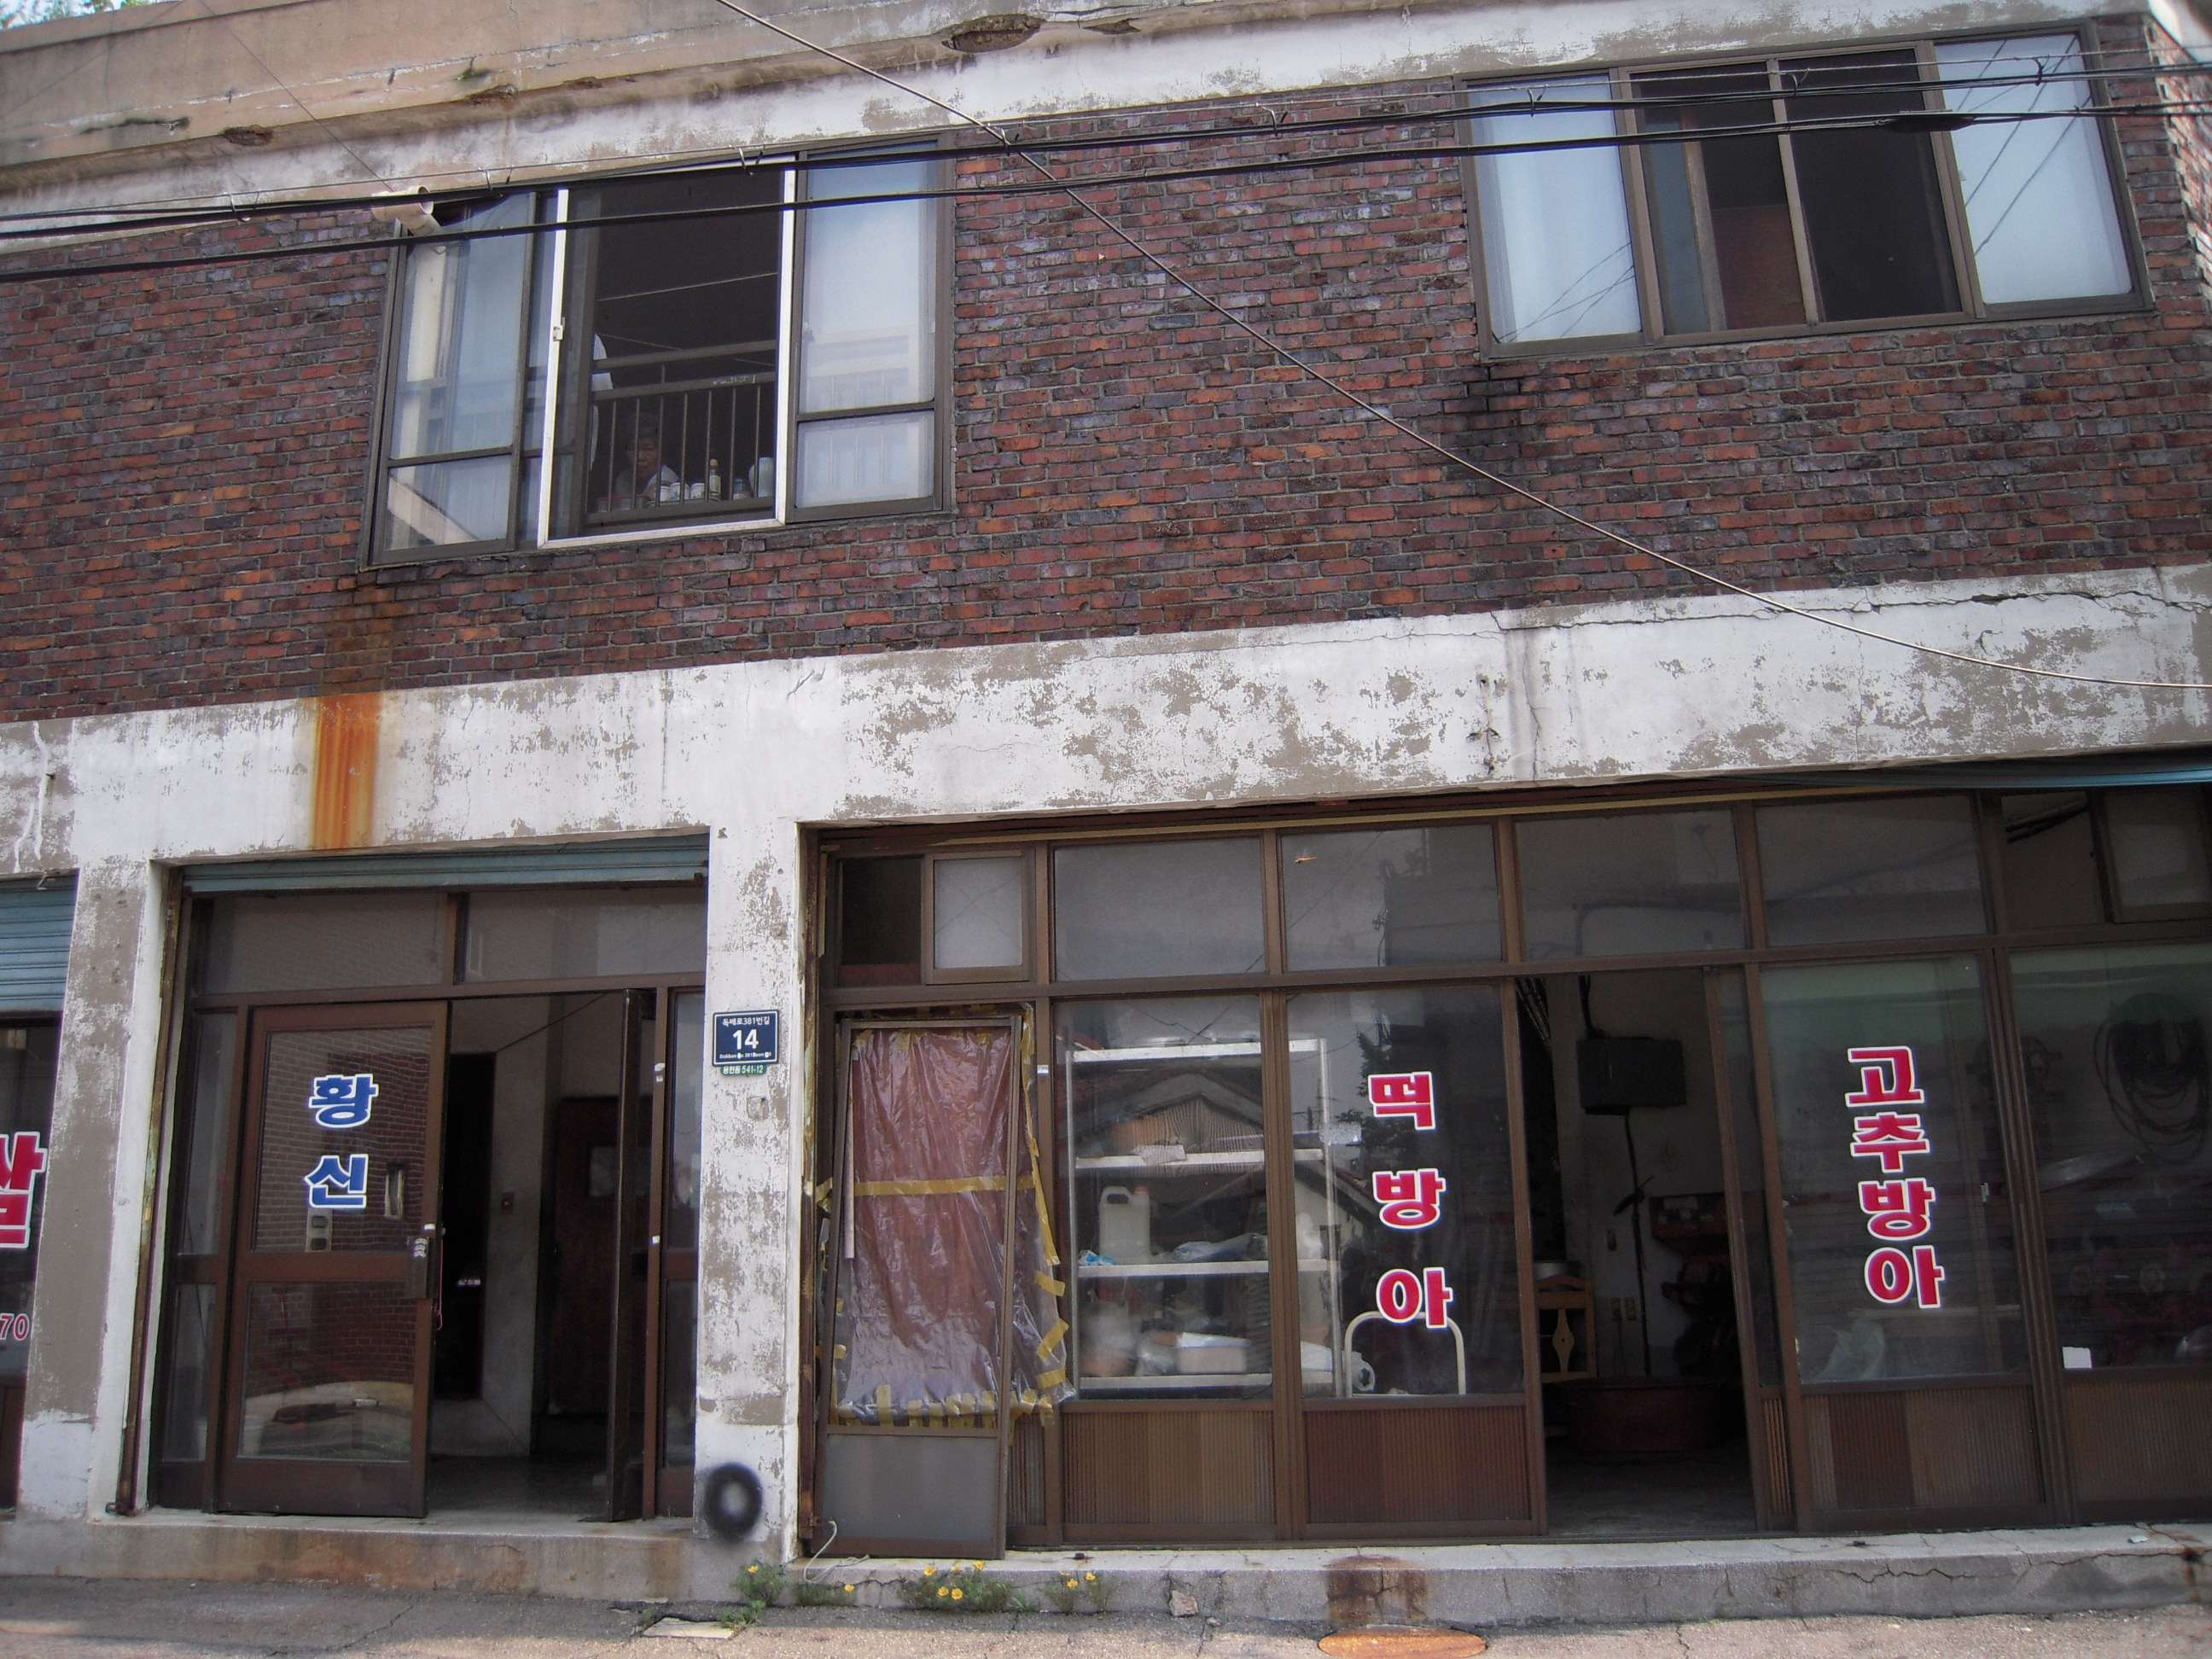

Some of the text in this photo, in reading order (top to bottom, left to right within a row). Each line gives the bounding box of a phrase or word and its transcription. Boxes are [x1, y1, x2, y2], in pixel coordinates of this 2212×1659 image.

[732, 1028, 760, 1050] 14
[742, 1064, 764, 1074] 541-12
[304, 1074, 379, 1208] 황신
[1368, 1071, 1452, 1328] 떡방아
[1845, 1046, 1945, 1308] 고추방아
